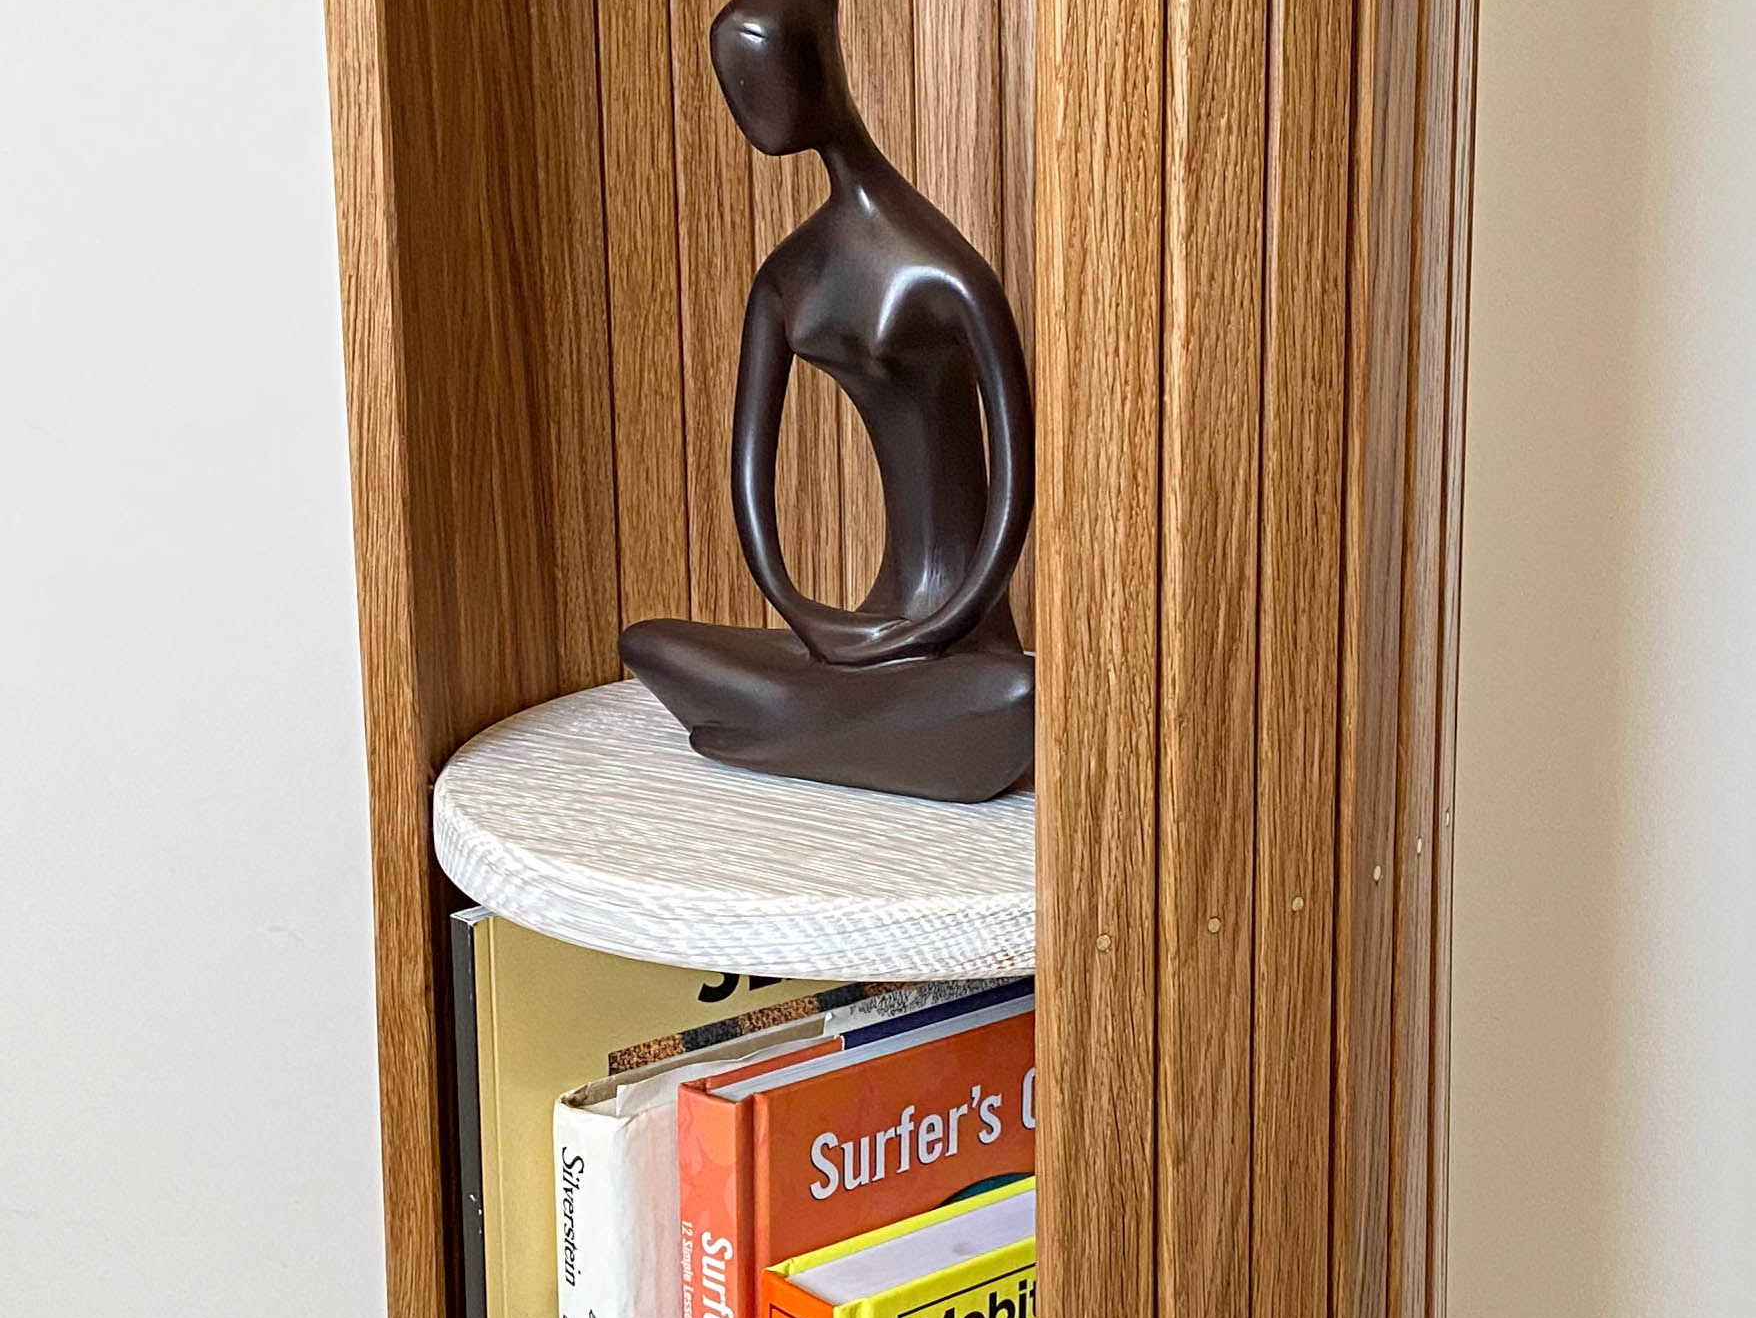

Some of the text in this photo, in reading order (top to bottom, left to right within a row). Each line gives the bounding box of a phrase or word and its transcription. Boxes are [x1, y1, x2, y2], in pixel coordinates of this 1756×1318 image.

[810, 1085, 1002, 1200] Surfer's
[562, 1146, 585, 1287] Silverstein
[682, 1220, 693, 1236] 12
[681, 1238, 694, 1283] Simple
